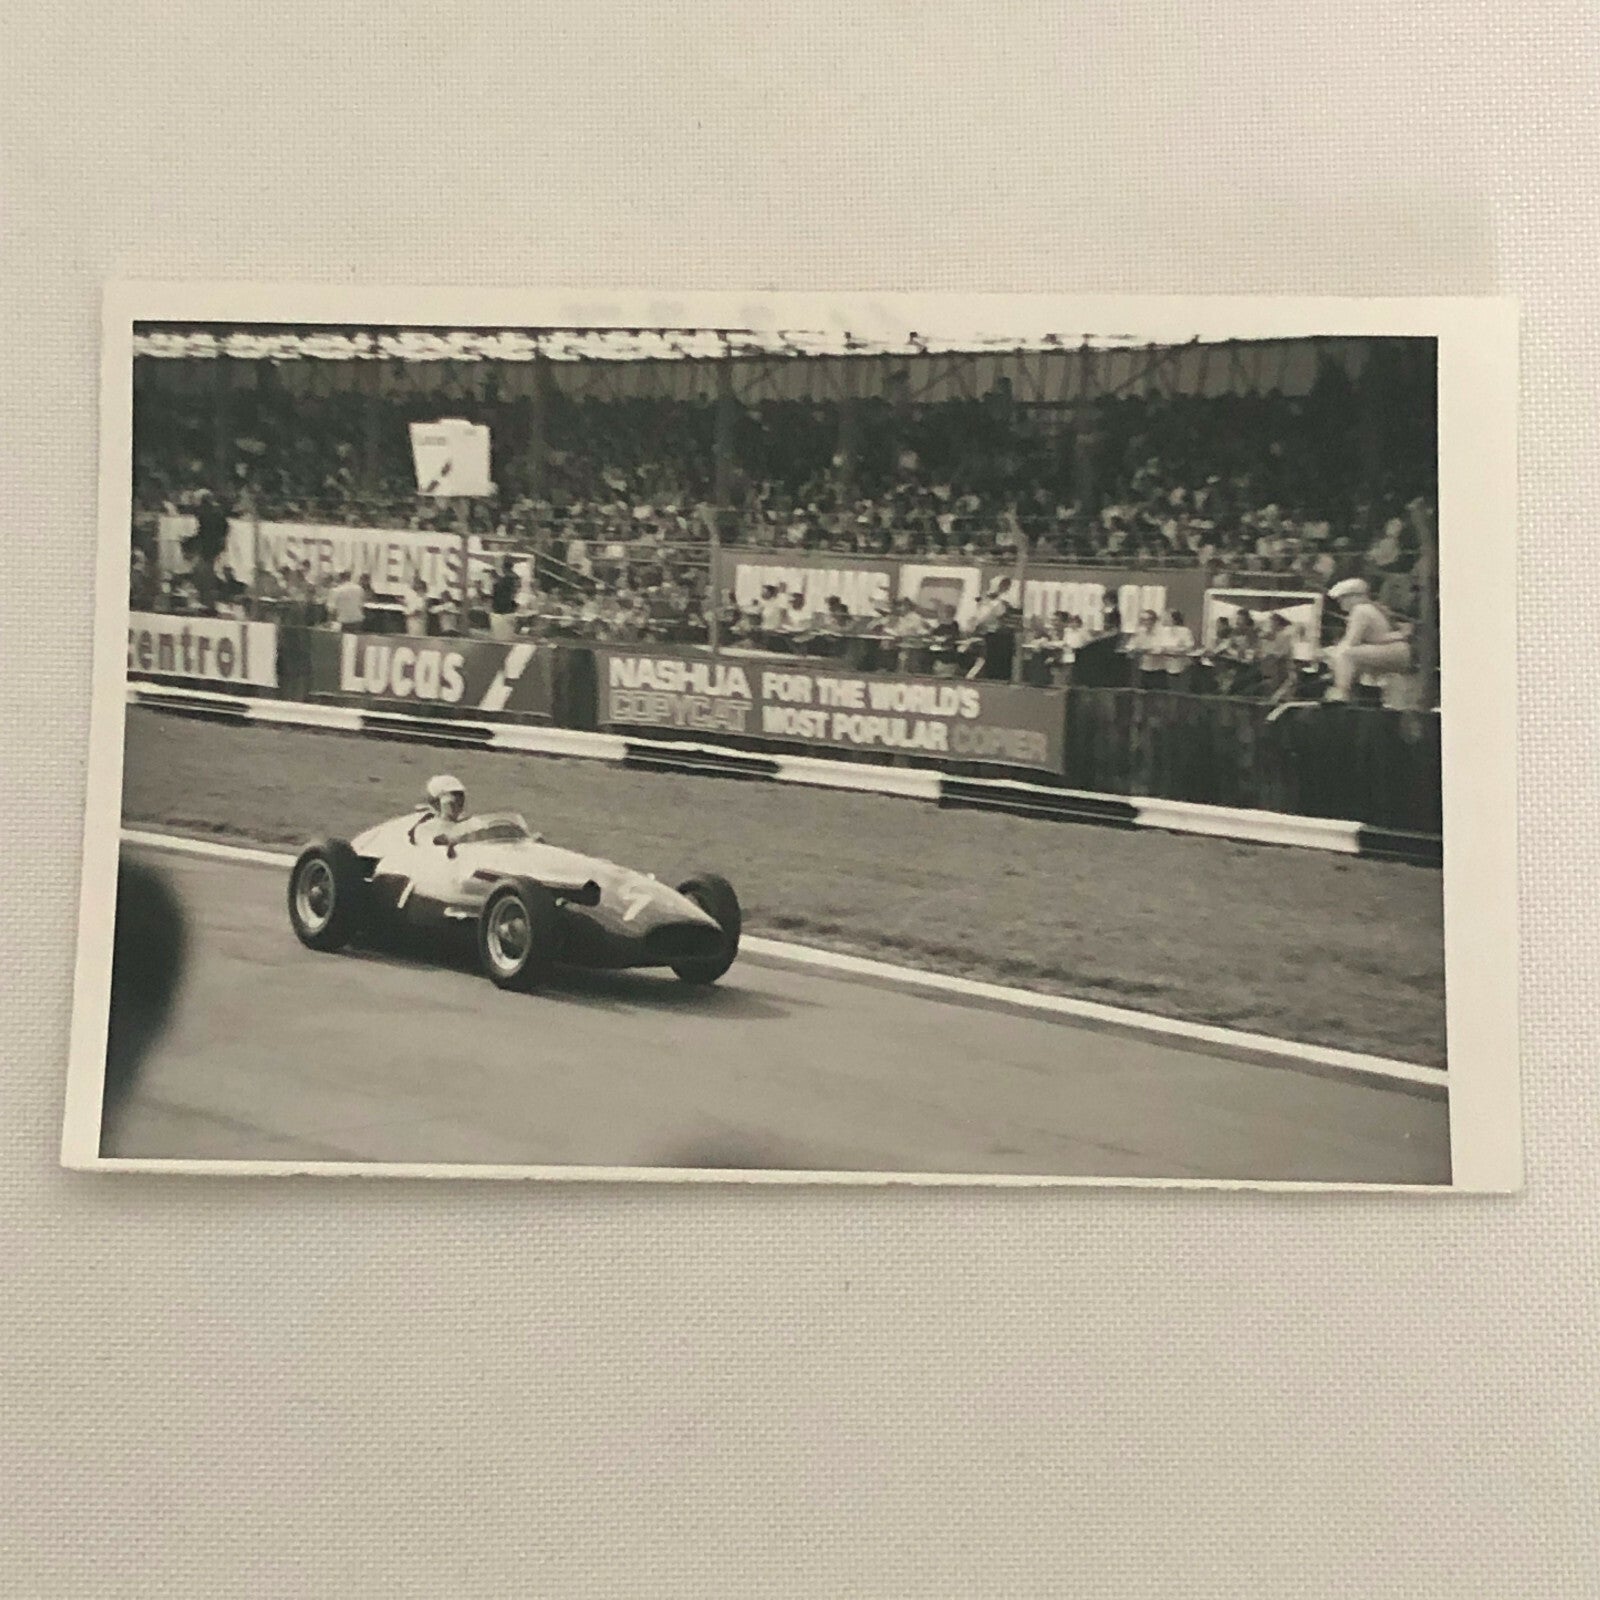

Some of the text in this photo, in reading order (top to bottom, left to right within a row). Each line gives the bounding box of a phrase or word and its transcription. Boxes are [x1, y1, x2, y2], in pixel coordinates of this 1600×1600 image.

[608, 656, 753, 699] NASHUA
[761, 671, 981, 719] FOR THE WORLD'S
[608, 689, 753, 732] COPYCAT
[761, 705, 1047, 762] MOST POPULAR COPIER
